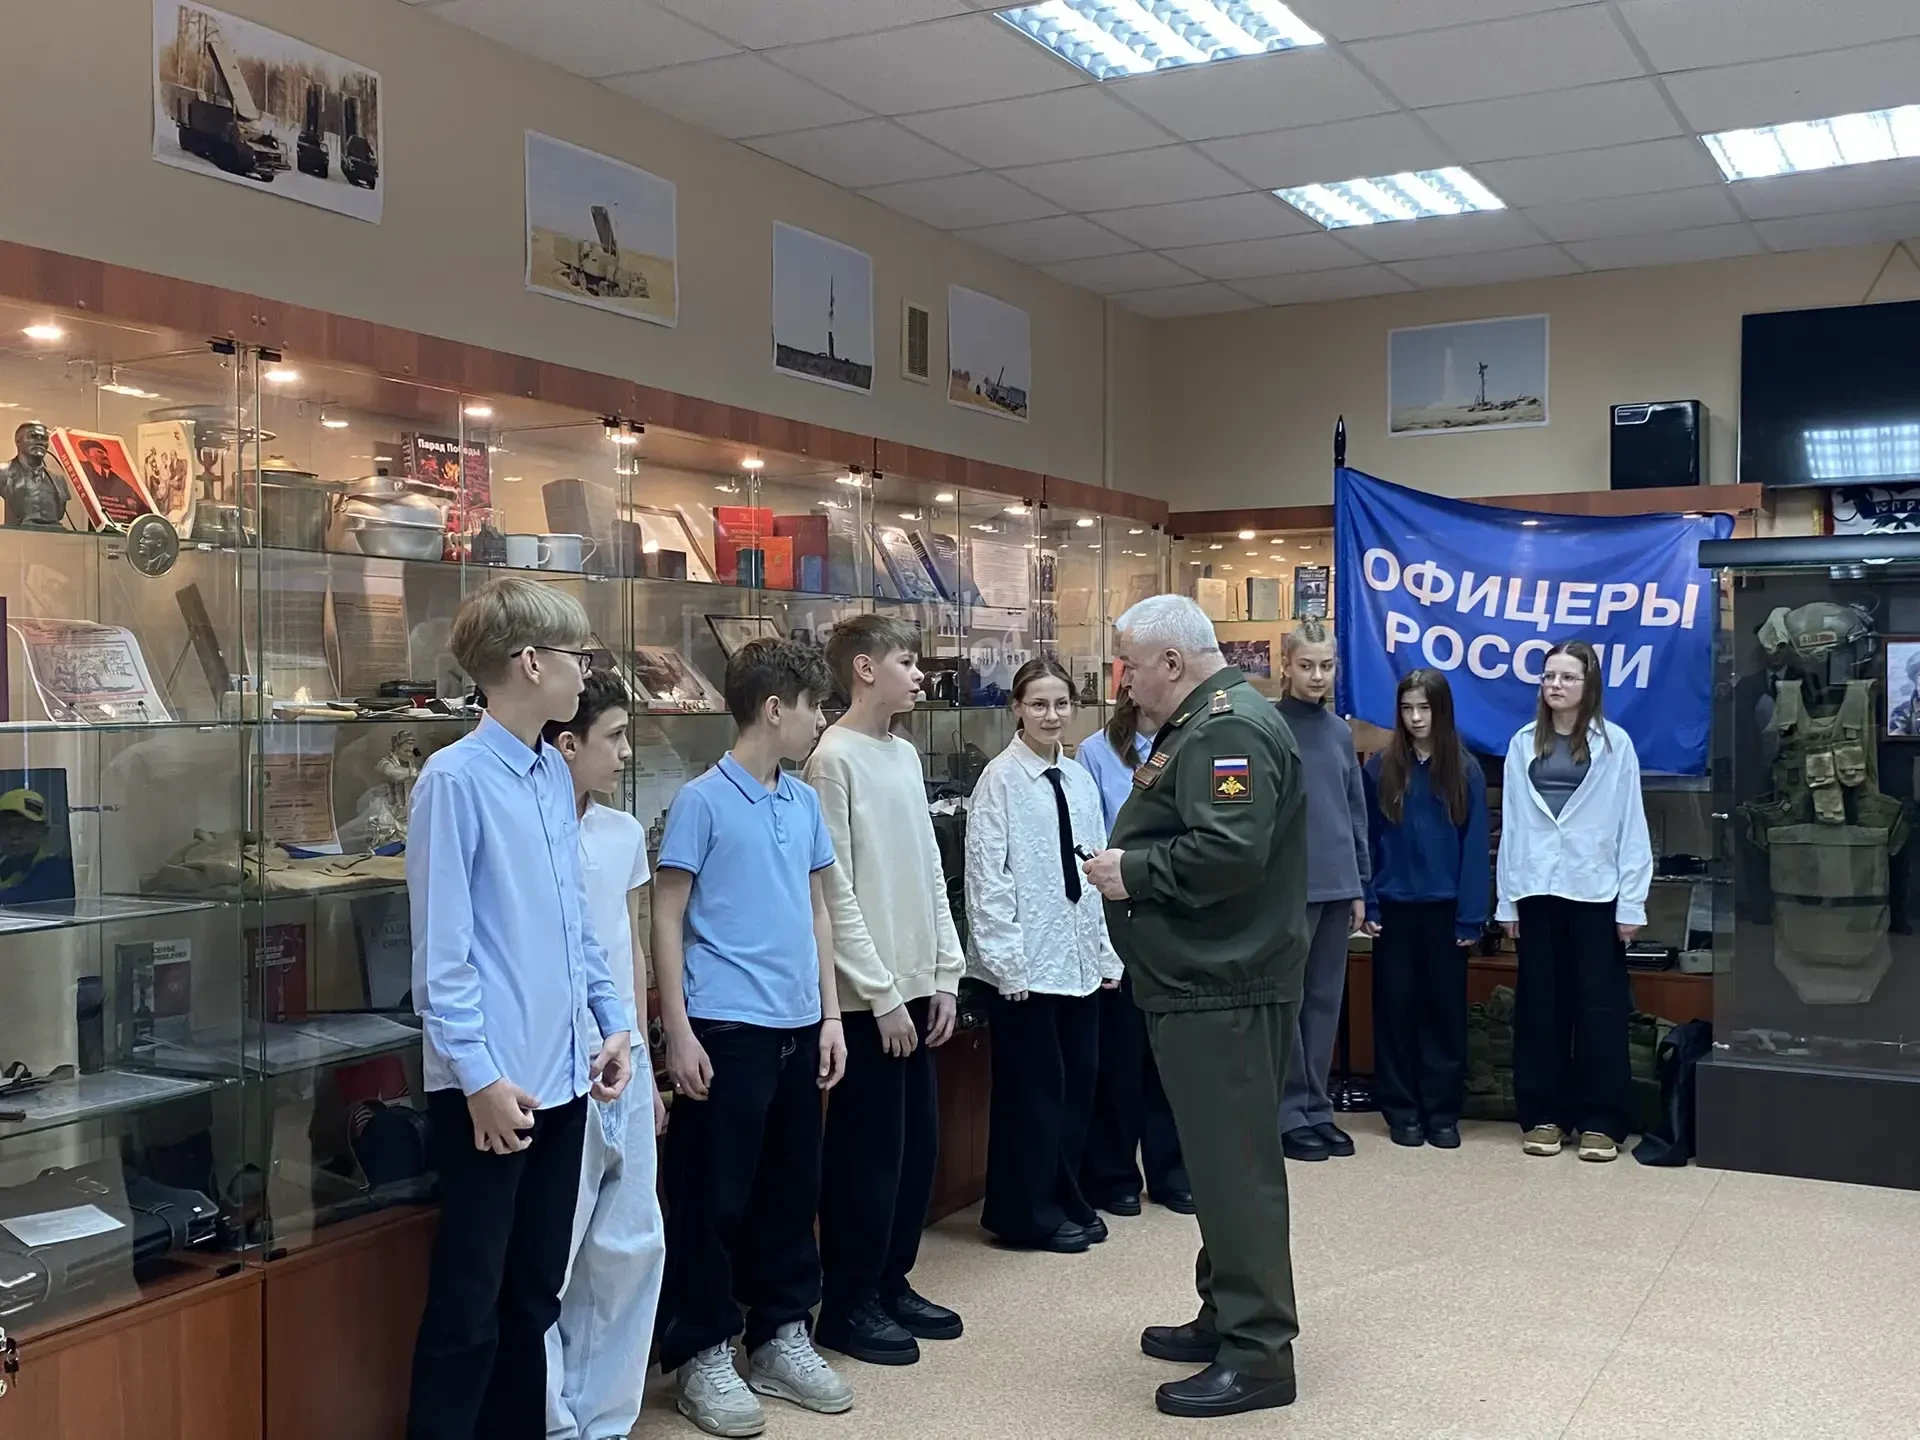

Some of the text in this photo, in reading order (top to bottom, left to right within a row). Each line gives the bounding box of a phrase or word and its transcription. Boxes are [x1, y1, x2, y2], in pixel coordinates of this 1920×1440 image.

[418, 438, 446, 454] Парад
[1363, 547, 1700, 632] ОФИЦЕРЫ
[1385, 611, 1654, 689] РОССИ
